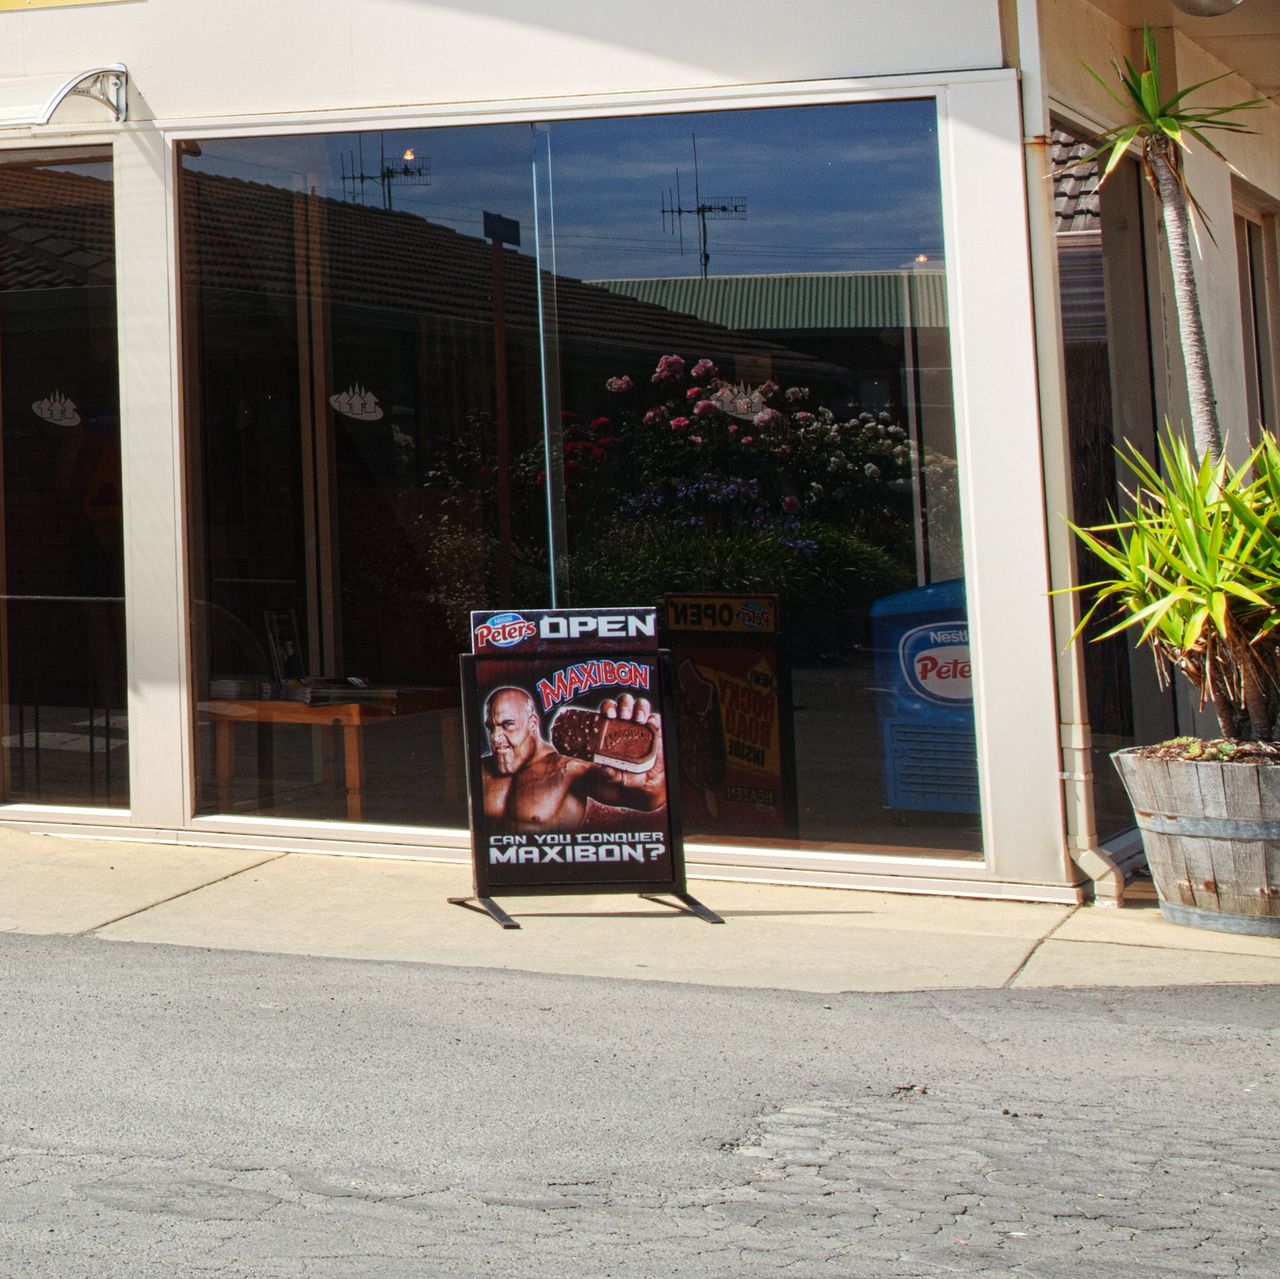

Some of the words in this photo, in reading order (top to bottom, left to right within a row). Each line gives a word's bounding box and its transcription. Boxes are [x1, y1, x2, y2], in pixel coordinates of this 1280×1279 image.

[475, 621, 537, 647] Peters
[539, 615, 655, 638] OPEN
[929, 630, 969, 643] Nestl
[916, 656, 972, 680] Pete
[537, 660, 650, 711] MAXIBON
[490, 835, 527, 845] CAN
[534, 834, 571, 844] YOU
[575, 832, 664, 843] CONQUER
[489, 844, 666, 864] MAXIBON?
